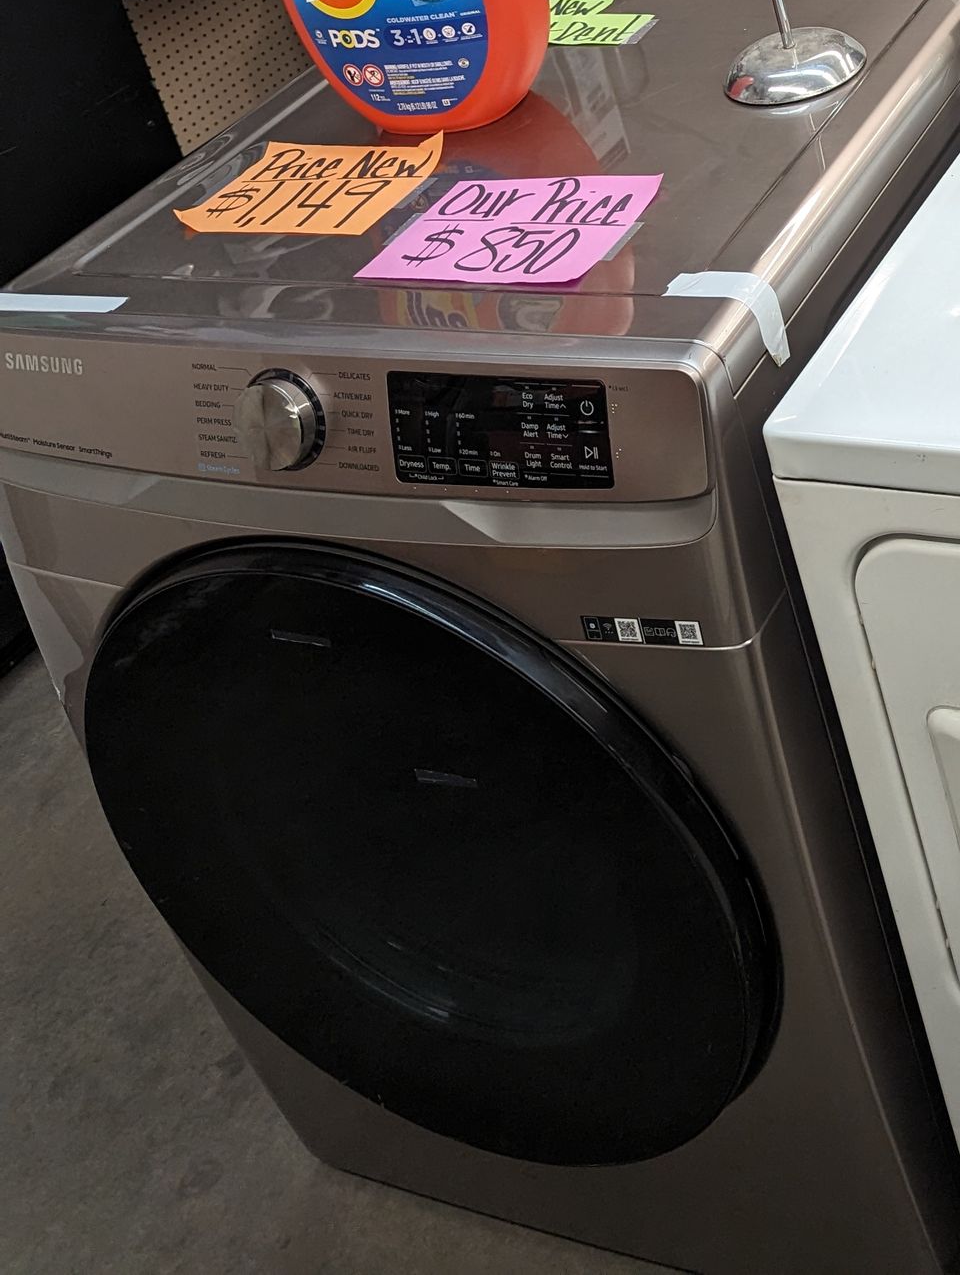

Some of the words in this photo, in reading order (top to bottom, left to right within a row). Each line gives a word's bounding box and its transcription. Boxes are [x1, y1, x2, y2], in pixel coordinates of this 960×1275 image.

[386, 15, 429, 24] COLDWATER
[430, 11, 456, 20] CLEAN
[329, 29, 380, 49] PODS
[252, 148, 343, 181] Price
[343, 151, 435, 178] New
[206, 181, 390, 227] $1,149
[438, 184, 535, 217] Our
[531, 178, 634, 225] Price
[454, 228, 581, 274] 850
[5, 352, 83, 376] SAMSUNG
[192, 363, 216, 371] NORMAL
[338, 371, 371, 381] DELICATES
[193, 383, 215, 391] HEAVY
[215, 384, 229, 392] DUTY
[333, 391, 372, 401] ACTIVEWEAR
[522, 392, 533, 400] Eco
[544, 393, 564, 402] Adjust
[195, 400, 221, 408] BEDDING
[522, 401, 533, 410] Dry
[197, 417, 213, 425] PERM
[214, 418, 232, 426] PRESS
[521, 422, 538, 431] Damp
[546, 423, 566, 432] Adjust
[523, 430, 538, 438] Alert
[200, 450, 226, 459] REFRESH
[524, 451, 541, 459] Drum
[551, 453, 569, 461] Smart
[399, 459, 424, 469] Dryness
[432, 462, 451, 471] Temp.
[464, 464, 481, 472] Time
[491, 462, 515, 471] Wrinkle
[526, 460, 542, 468] Light
[550, 461, 572, 469] Control
[492, 470, 516, 478] Prevent
